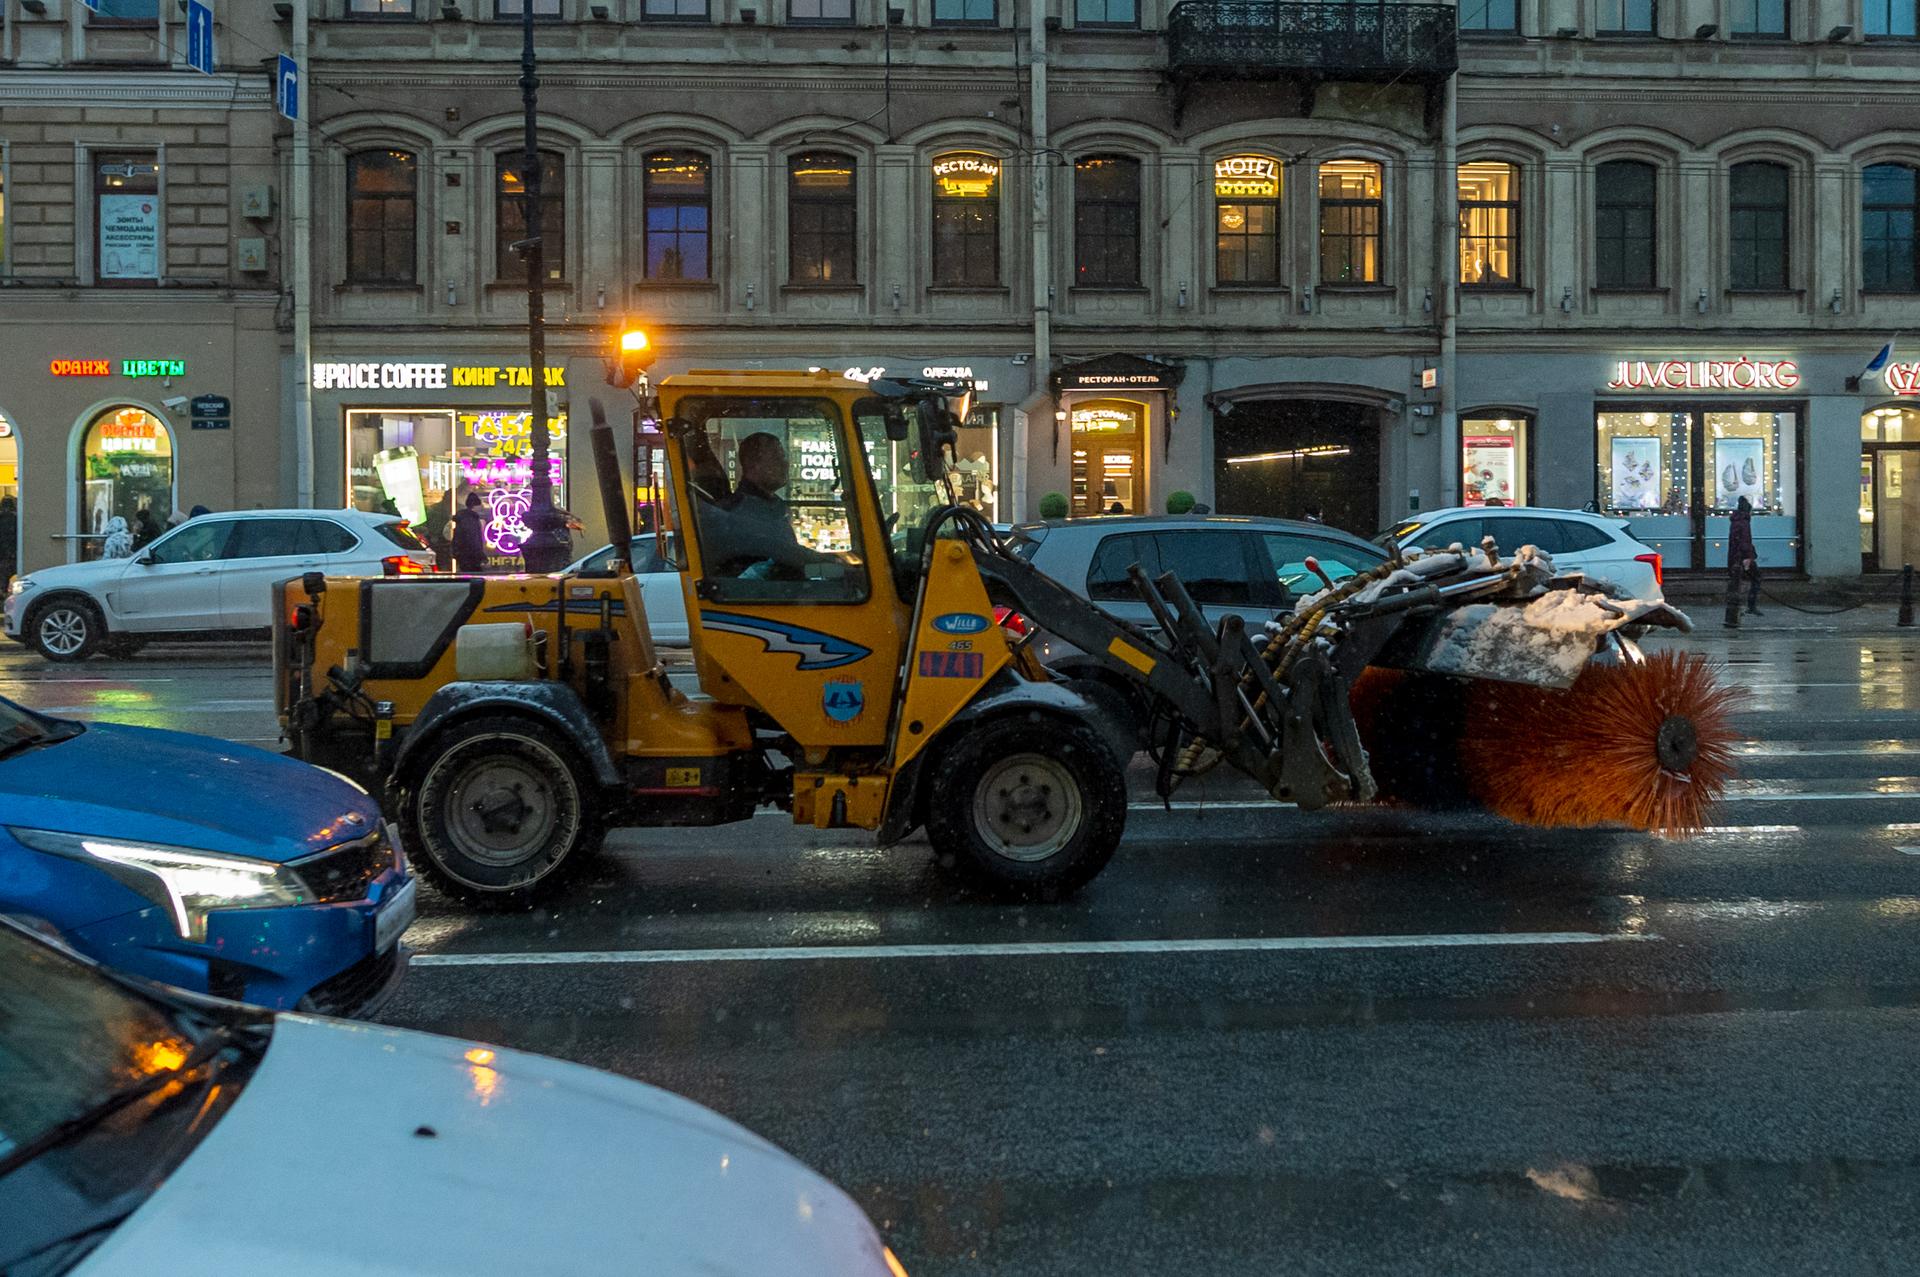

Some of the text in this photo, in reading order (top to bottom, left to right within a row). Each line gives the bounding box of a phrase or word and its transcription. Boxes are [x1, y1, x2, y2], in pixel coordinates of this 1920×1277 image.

[1215, 158, 1278, 179] HOTEL
[105, 225, 155, 233] ЧЕМОДАНЫ
[50, 360, 110, 376] ОРАНЖ
[122, 360, 185, 378] ЦВЕТЫ
[326, 363, 380, 389] PRICE
[381, 363, 447, 389] COFFEE
[452, 367, 566, 387] КИНГ-ТААК
[922, 367, 973, 378] ОДЕЖДА
